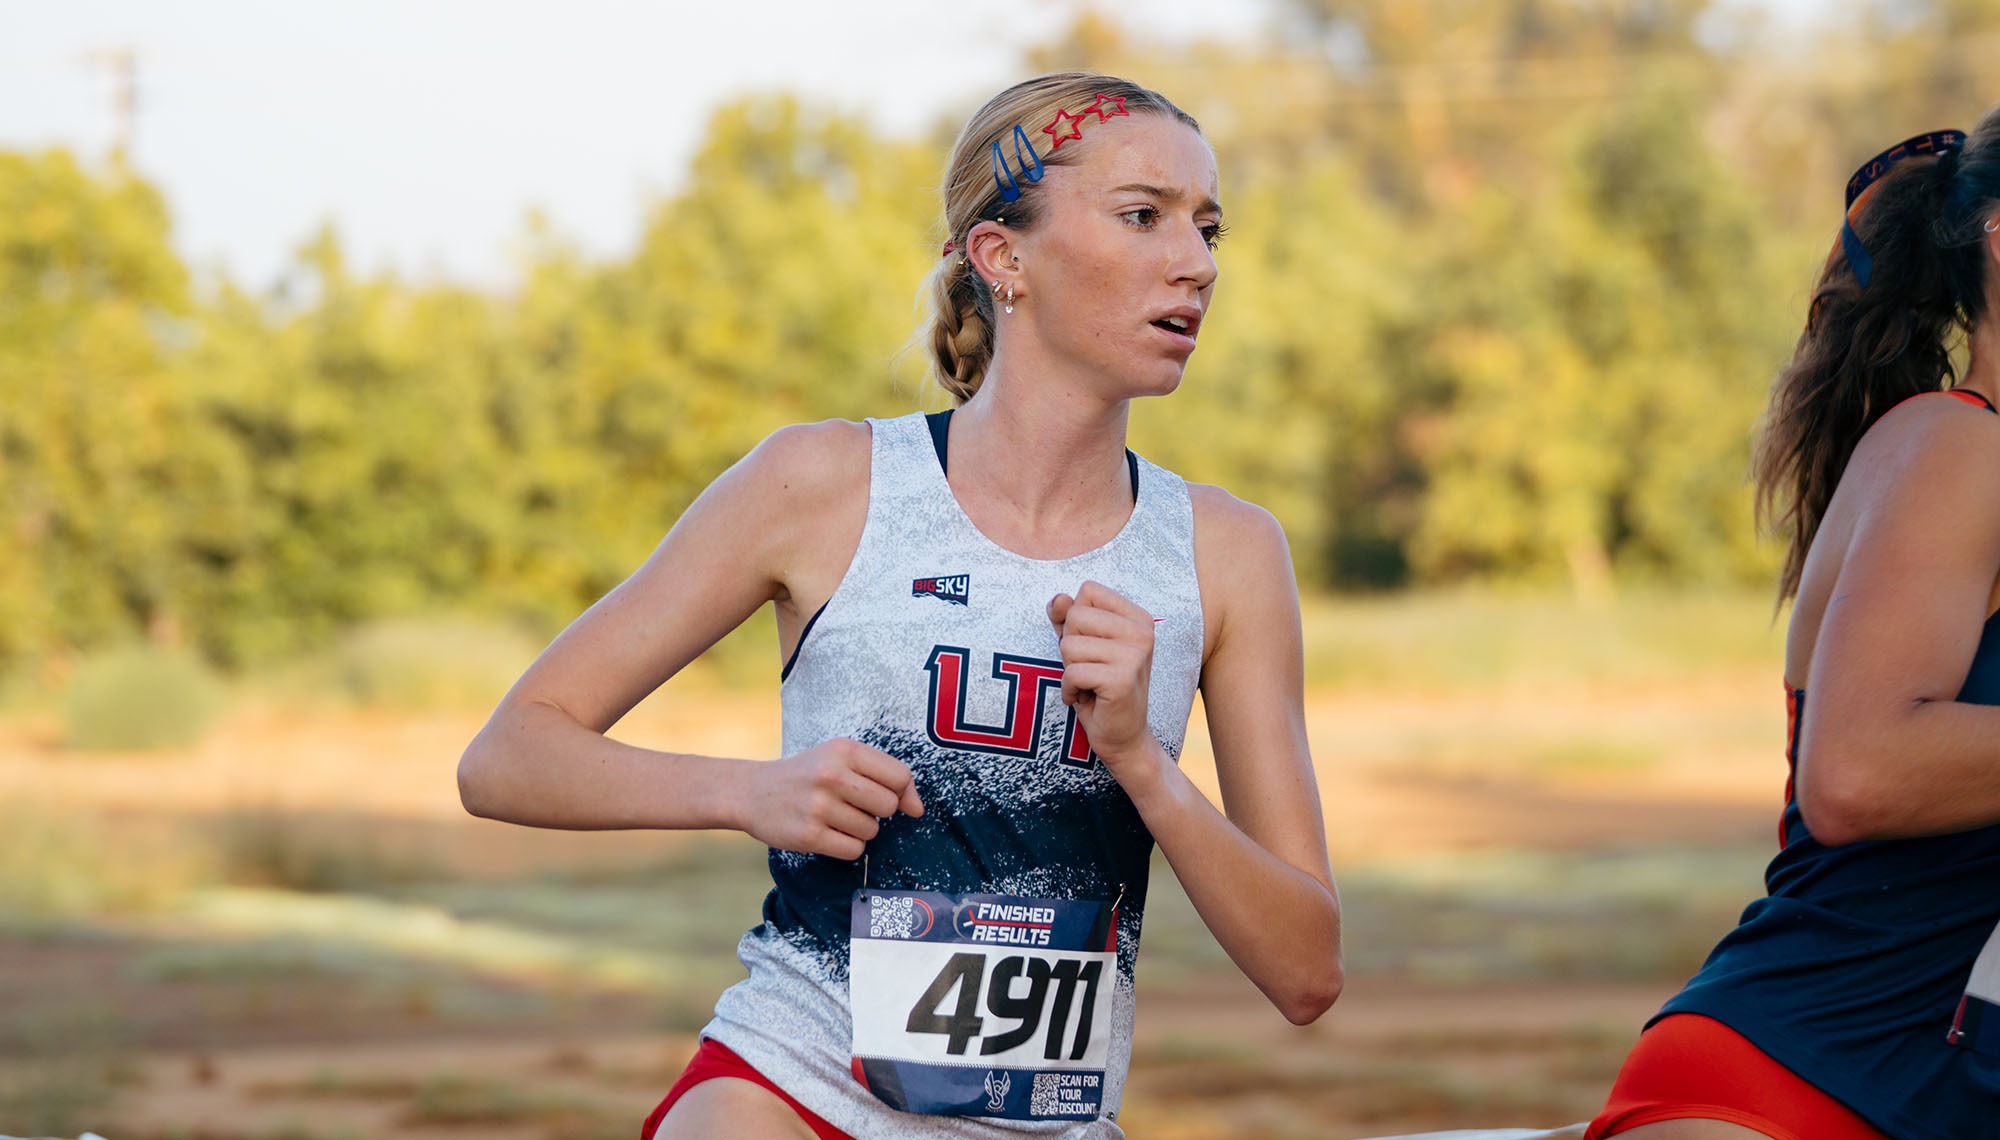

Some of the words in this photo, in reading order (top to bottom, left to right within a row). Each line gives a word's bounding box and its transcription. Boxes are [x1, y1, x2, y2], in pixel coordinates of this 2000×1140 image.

[977, 903, 1055, 923] FINISHED
[971, 924, 1051, 946] RESULTS
[906, 952, 1103, 1060] 4911
[1060, 1074, 1082, 1087] SCAN
[1083, 1075, 1099, 1087] FOR
[1060, 1088, 1082, 1101] YOUR
[1059, 1102, 1096, 1115] DISCOUNT
